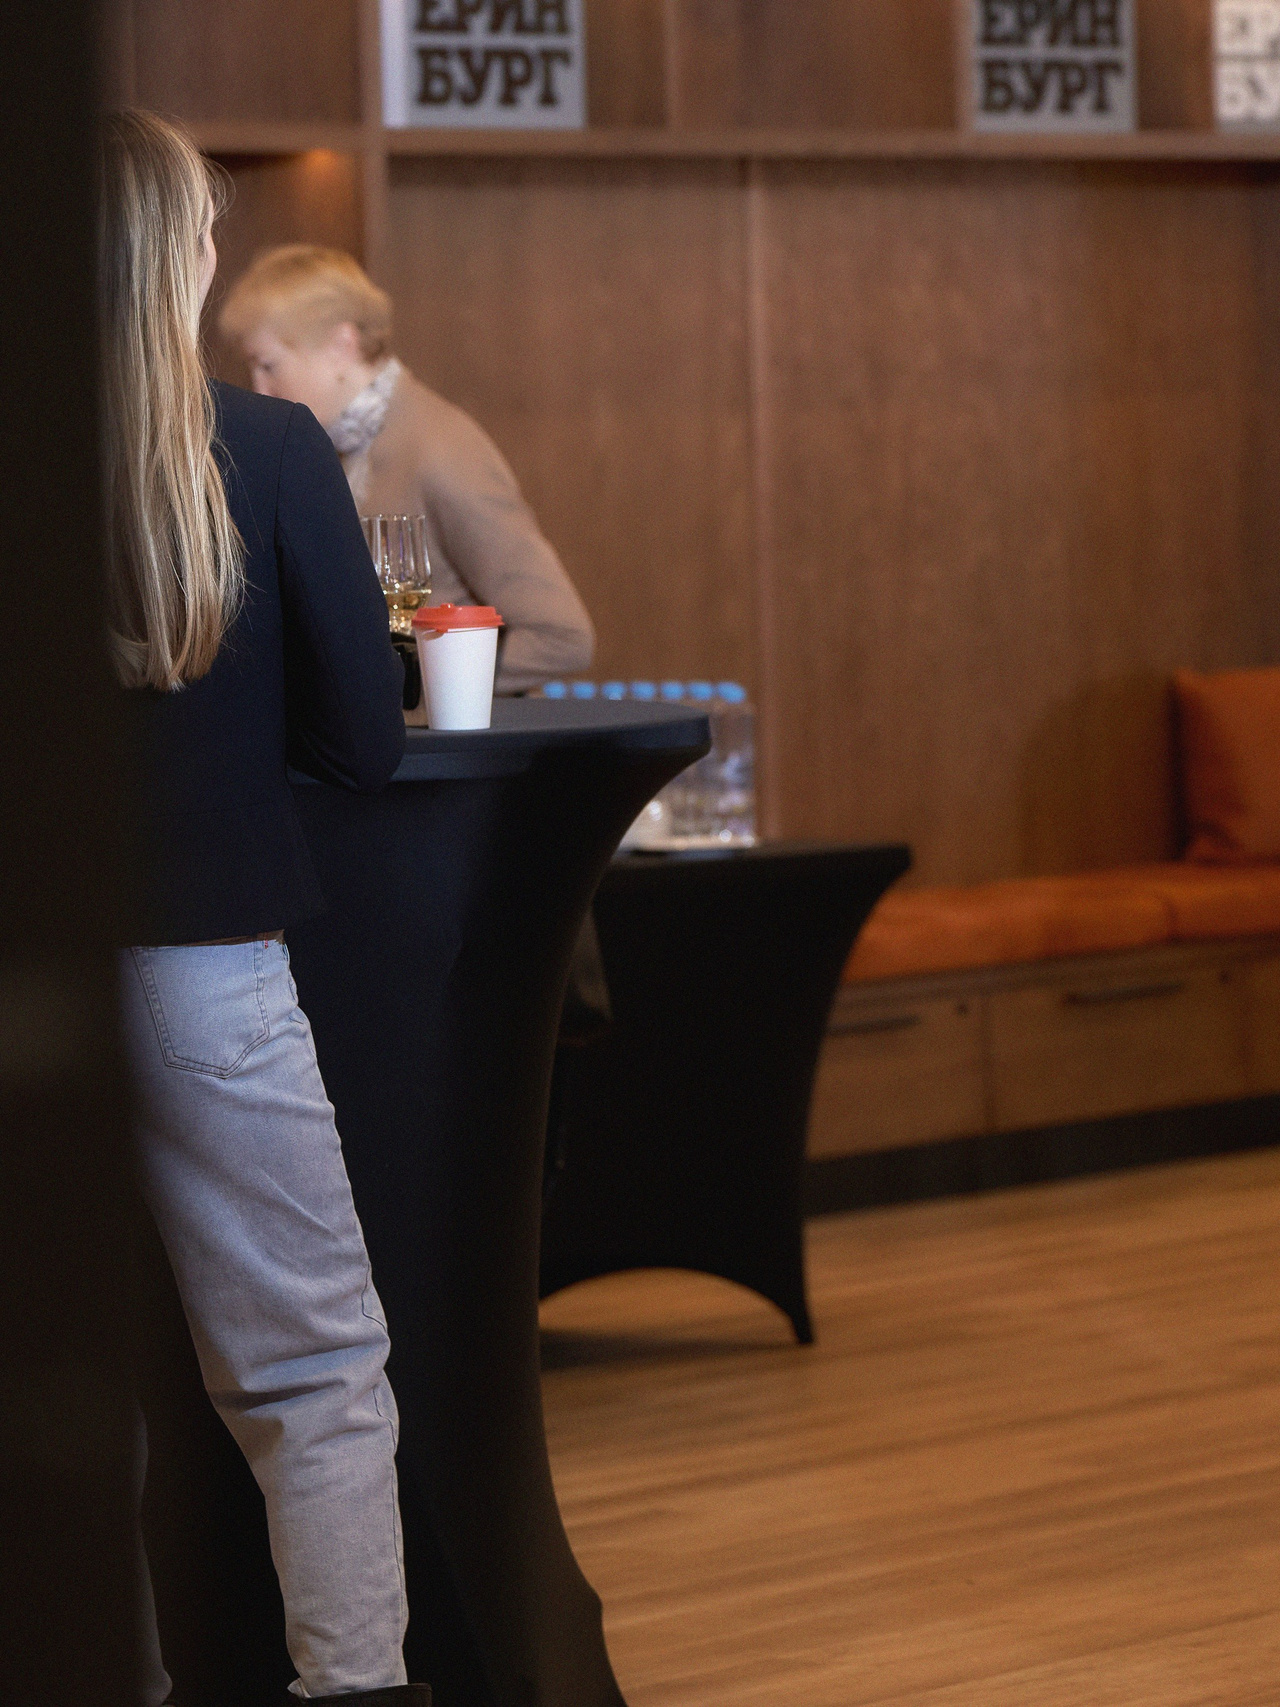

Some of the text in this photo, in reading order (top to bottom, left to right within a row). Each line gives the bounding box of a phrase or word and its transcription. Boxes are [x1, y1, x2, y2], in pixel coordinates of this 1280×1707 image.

[415, 0, 569, 35] ЕРИН
[979, 0, 1121, 47] ЕРИН
[416, 47, 571, 107] БУРГ
[979, 59, 1123, 114] БУРГ
